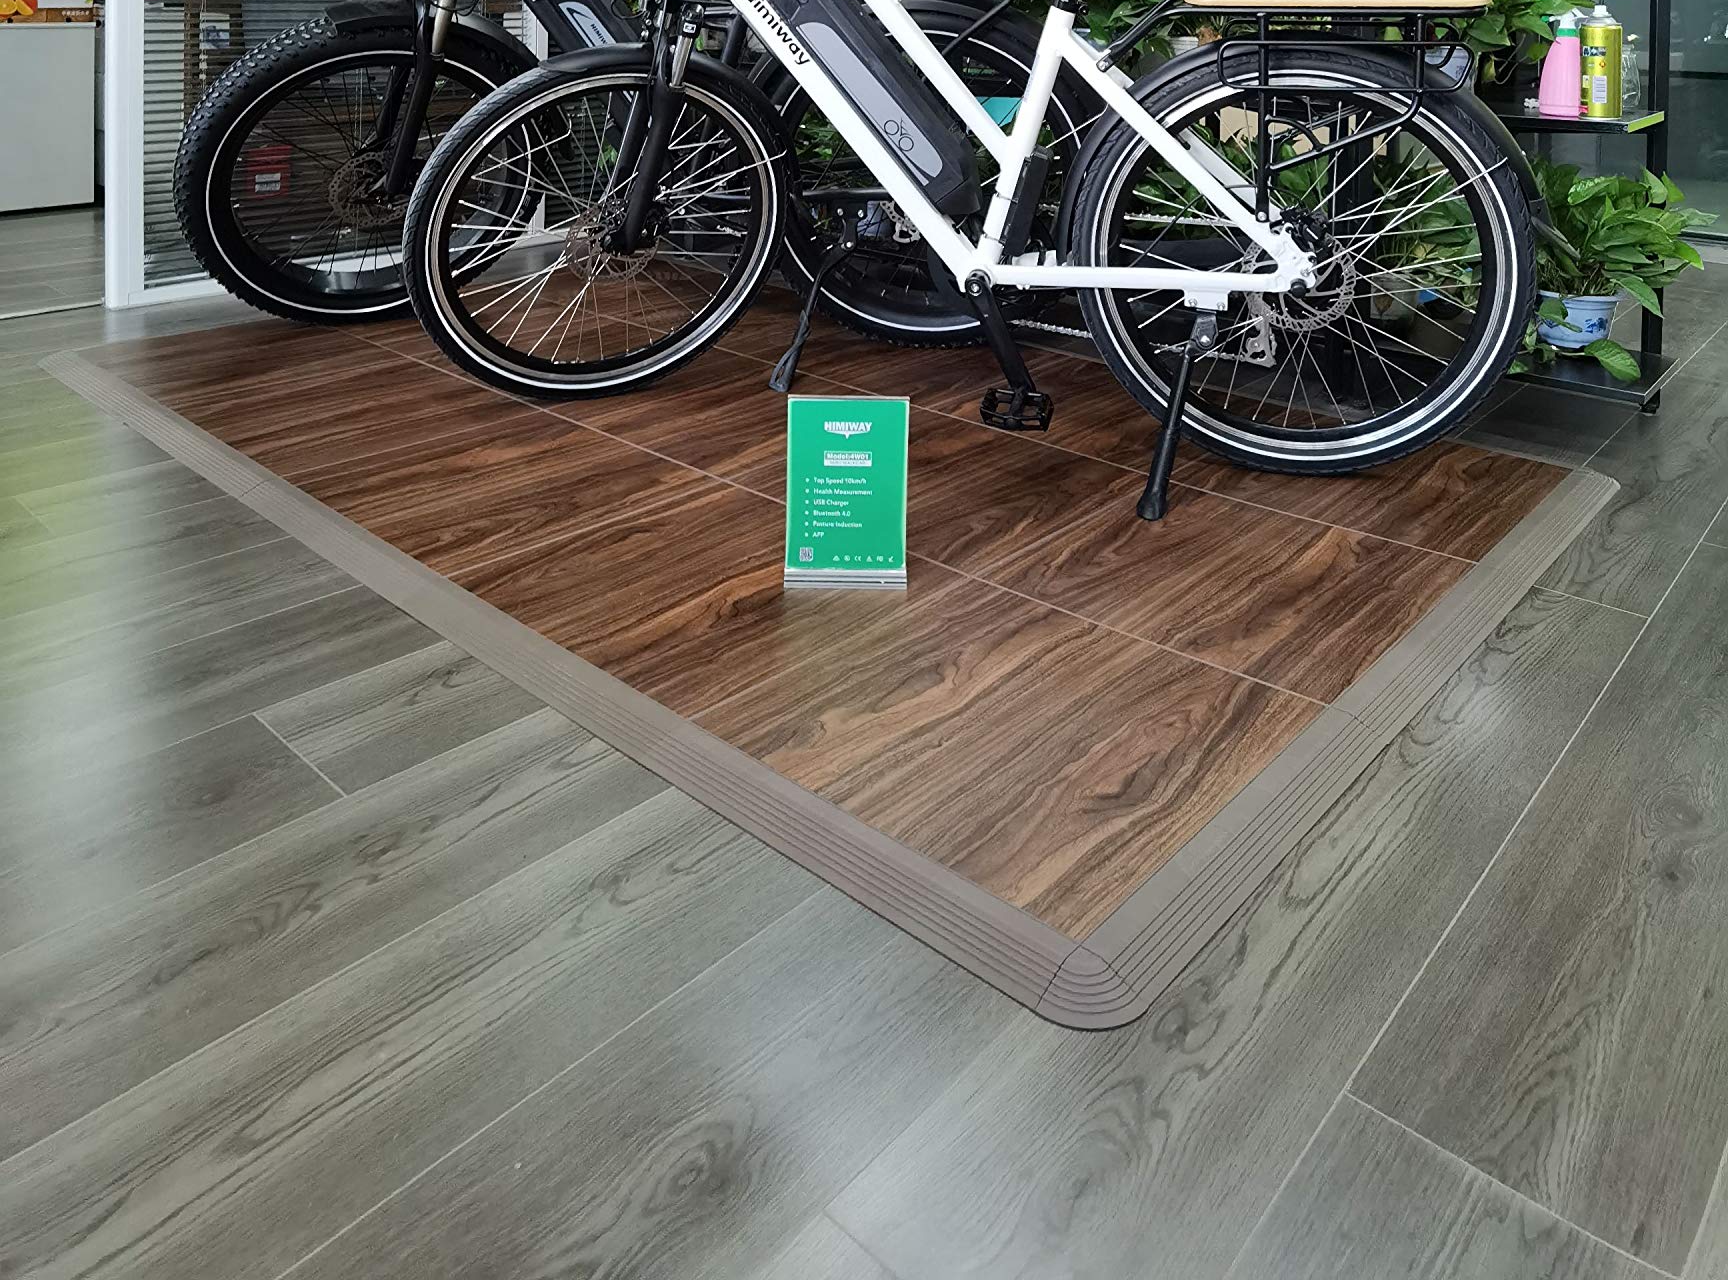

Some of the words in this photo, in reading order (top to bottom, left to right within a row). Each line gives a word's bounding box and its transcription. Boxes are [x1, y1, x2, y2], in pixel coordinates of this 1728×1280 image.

[824, 421, 872, 432] HIMIWAY
[813, 477, 825, 485] Top
[826, 477, 844, 485] Speed
[834, 488, 873, 496] Measurement
[826, 499, 849, 507] Charger
